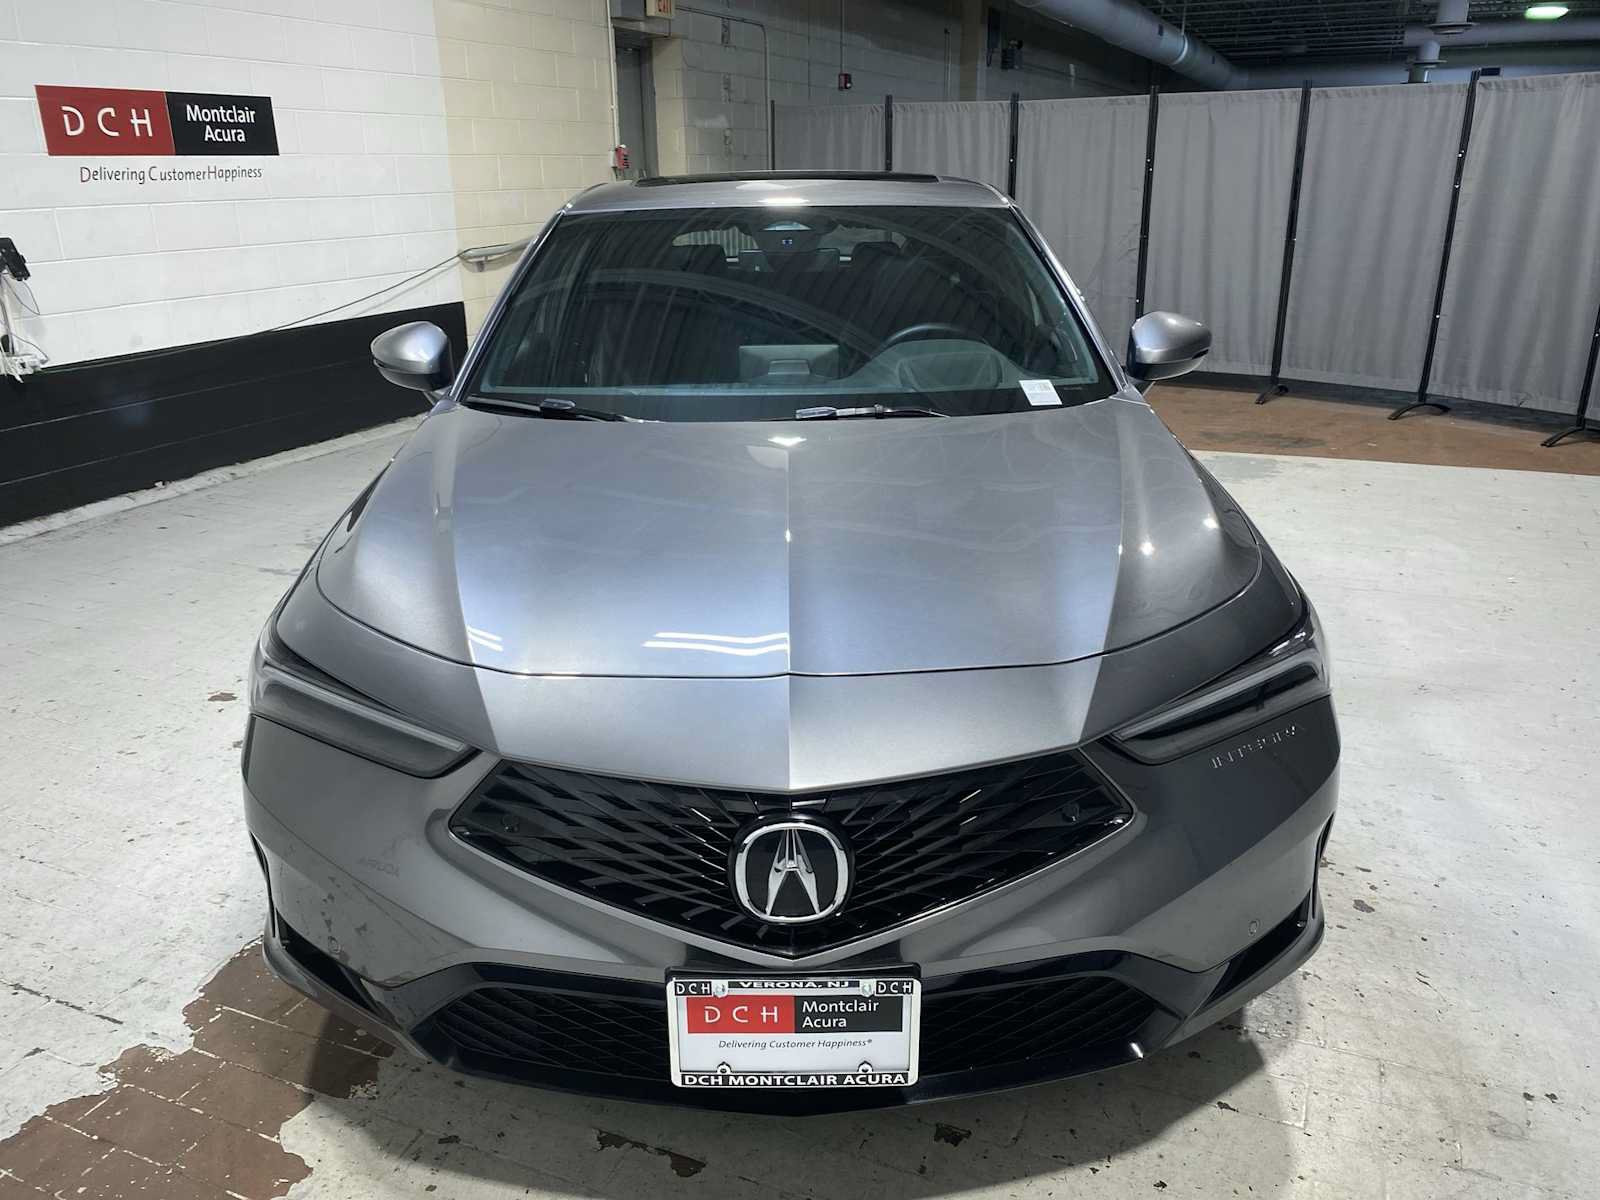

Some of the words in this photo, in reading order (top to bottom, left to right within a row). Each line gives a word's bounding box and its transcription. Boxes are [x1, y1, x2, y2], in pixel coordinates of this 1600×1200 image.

[186, 103, 257, 124] Montclair
[203, 124, 247, 143] Acura
[79, 166, 146, 185] Delivering
[827, 981, 849, 989] NJ
[802, 999, 880, 1013] Montclair
[802, 1016, 847, 1028] Acura
[718, 1040, 767, 1051] Delivering
[769, 1040, 816, 1049] Customer
[684, 1075, 723, 1086] DCH
[728, 1075, 838, 1086] MONTCLAIR
[842, 1073, 906, 1085] ACURA
